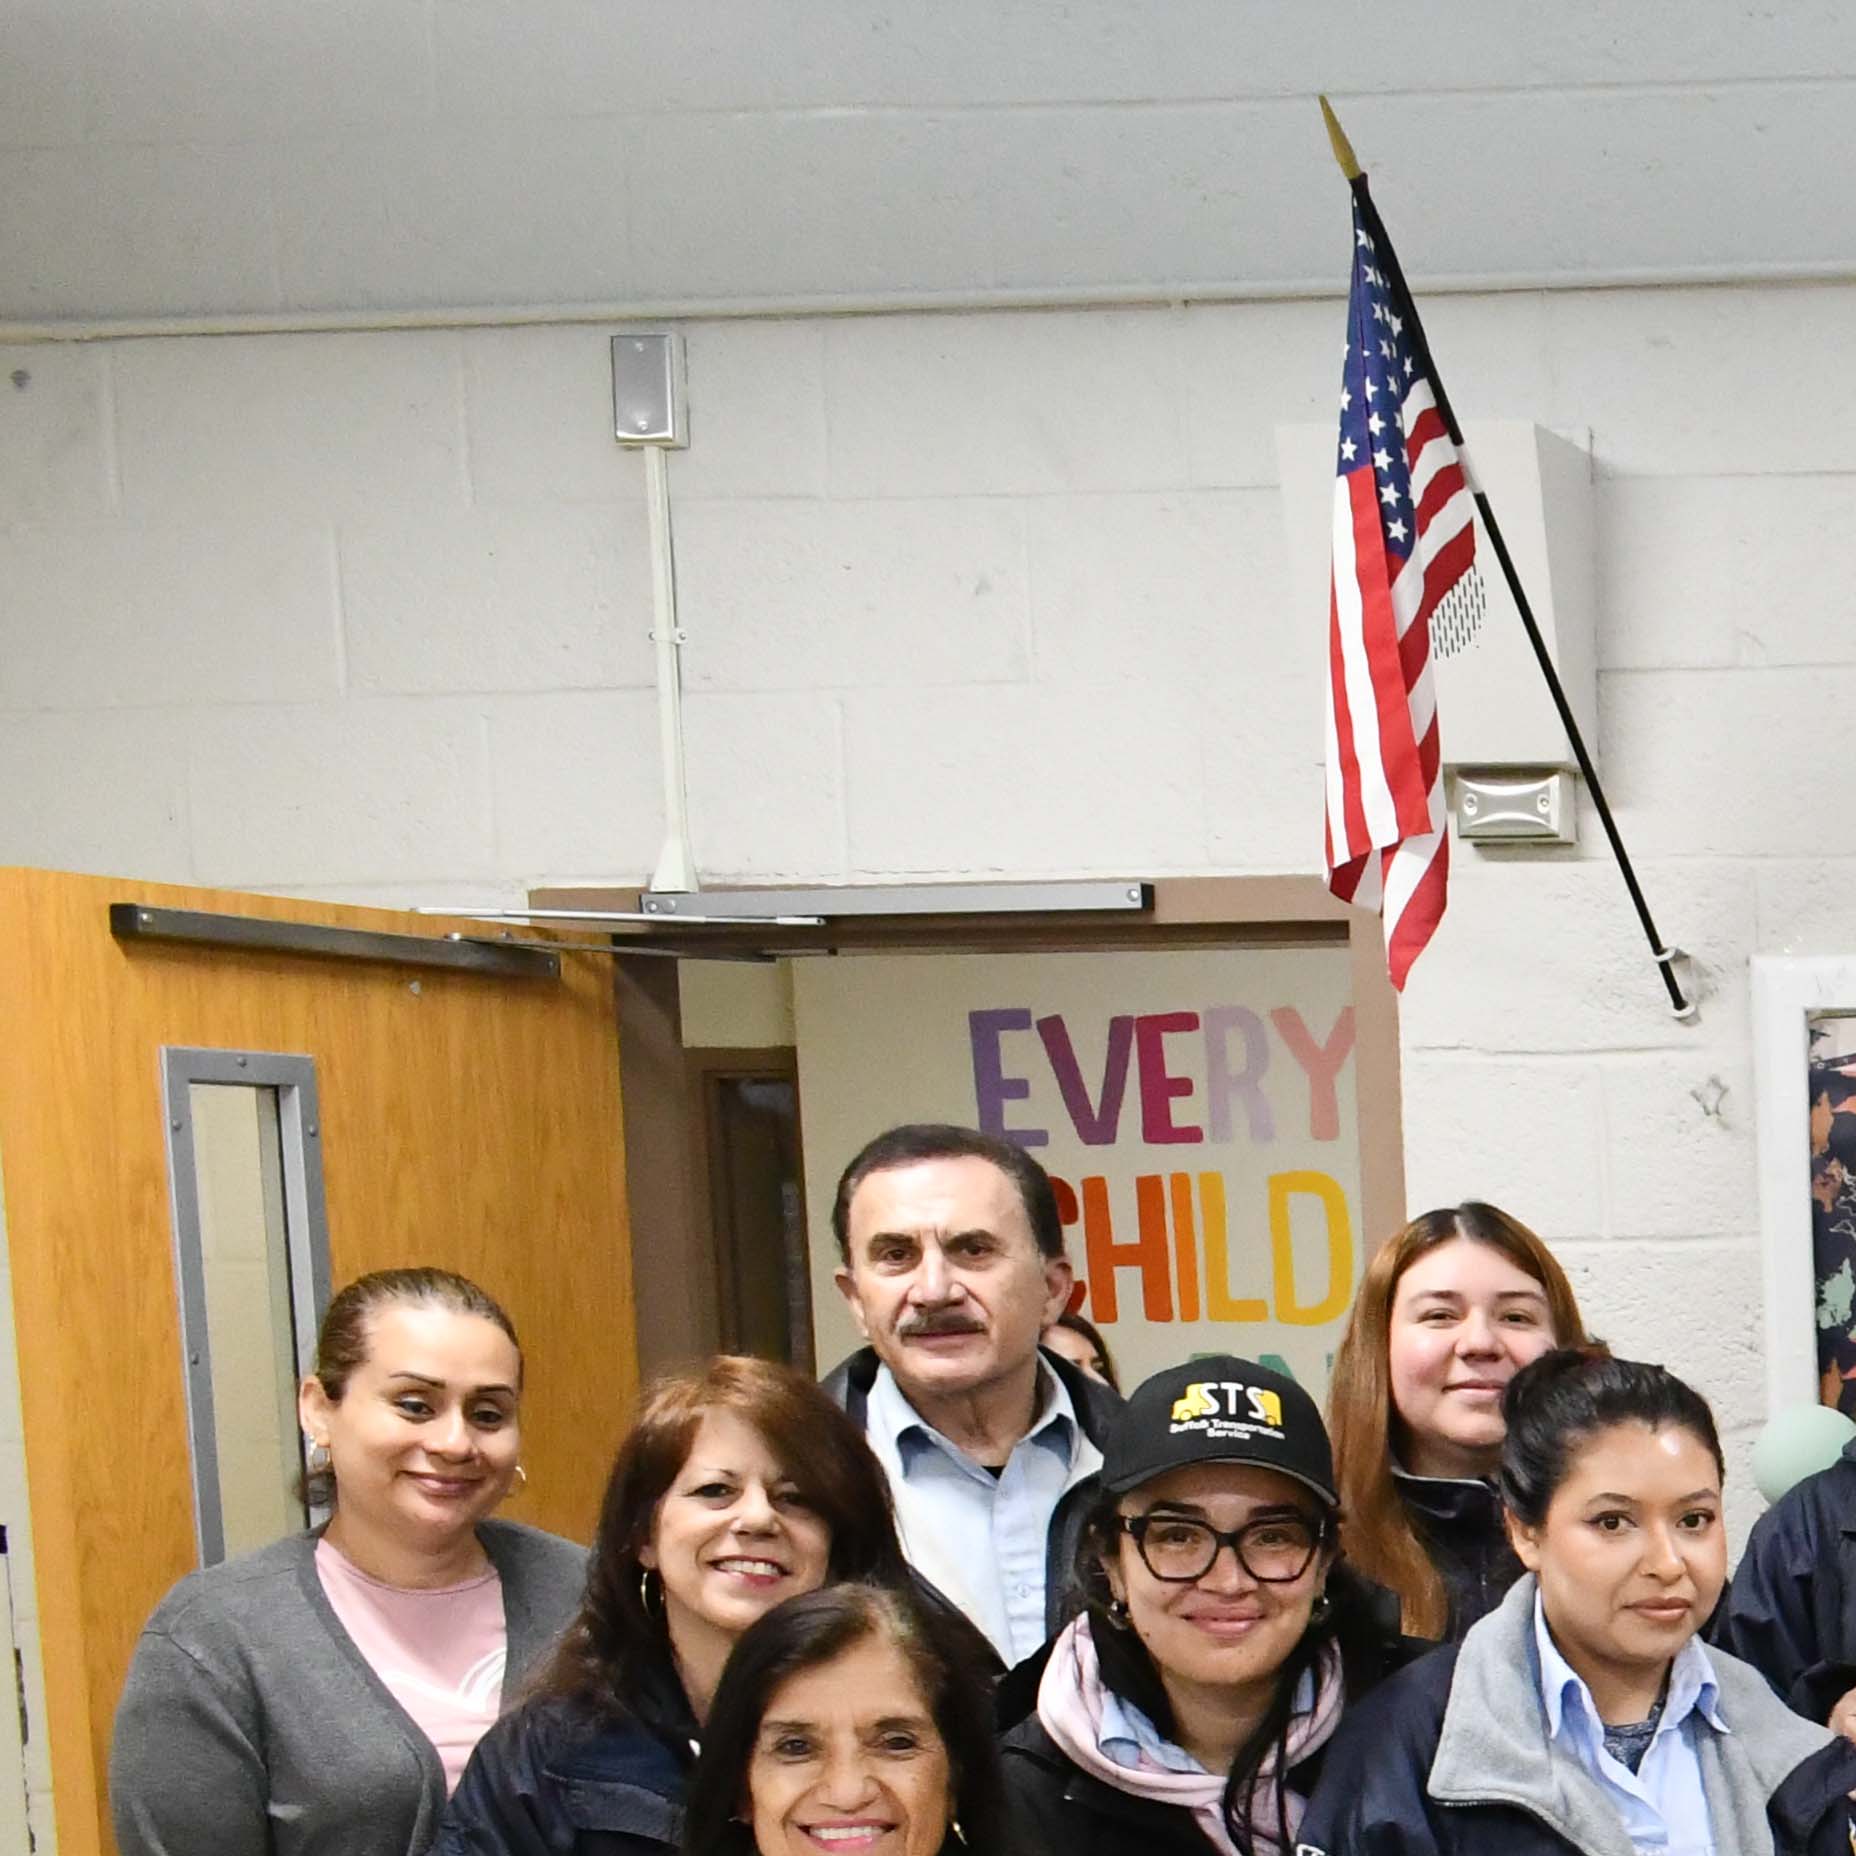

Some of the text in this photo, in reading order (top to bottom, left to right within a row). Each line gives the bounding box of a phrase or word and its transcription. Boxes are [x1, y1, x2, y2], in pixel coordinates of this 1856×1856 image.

[968, 1004, 1356, 1147] EVERY
[1046, 1170, 1354, 1326] HILD
[1199, 1381, 1267, 1423] STS
